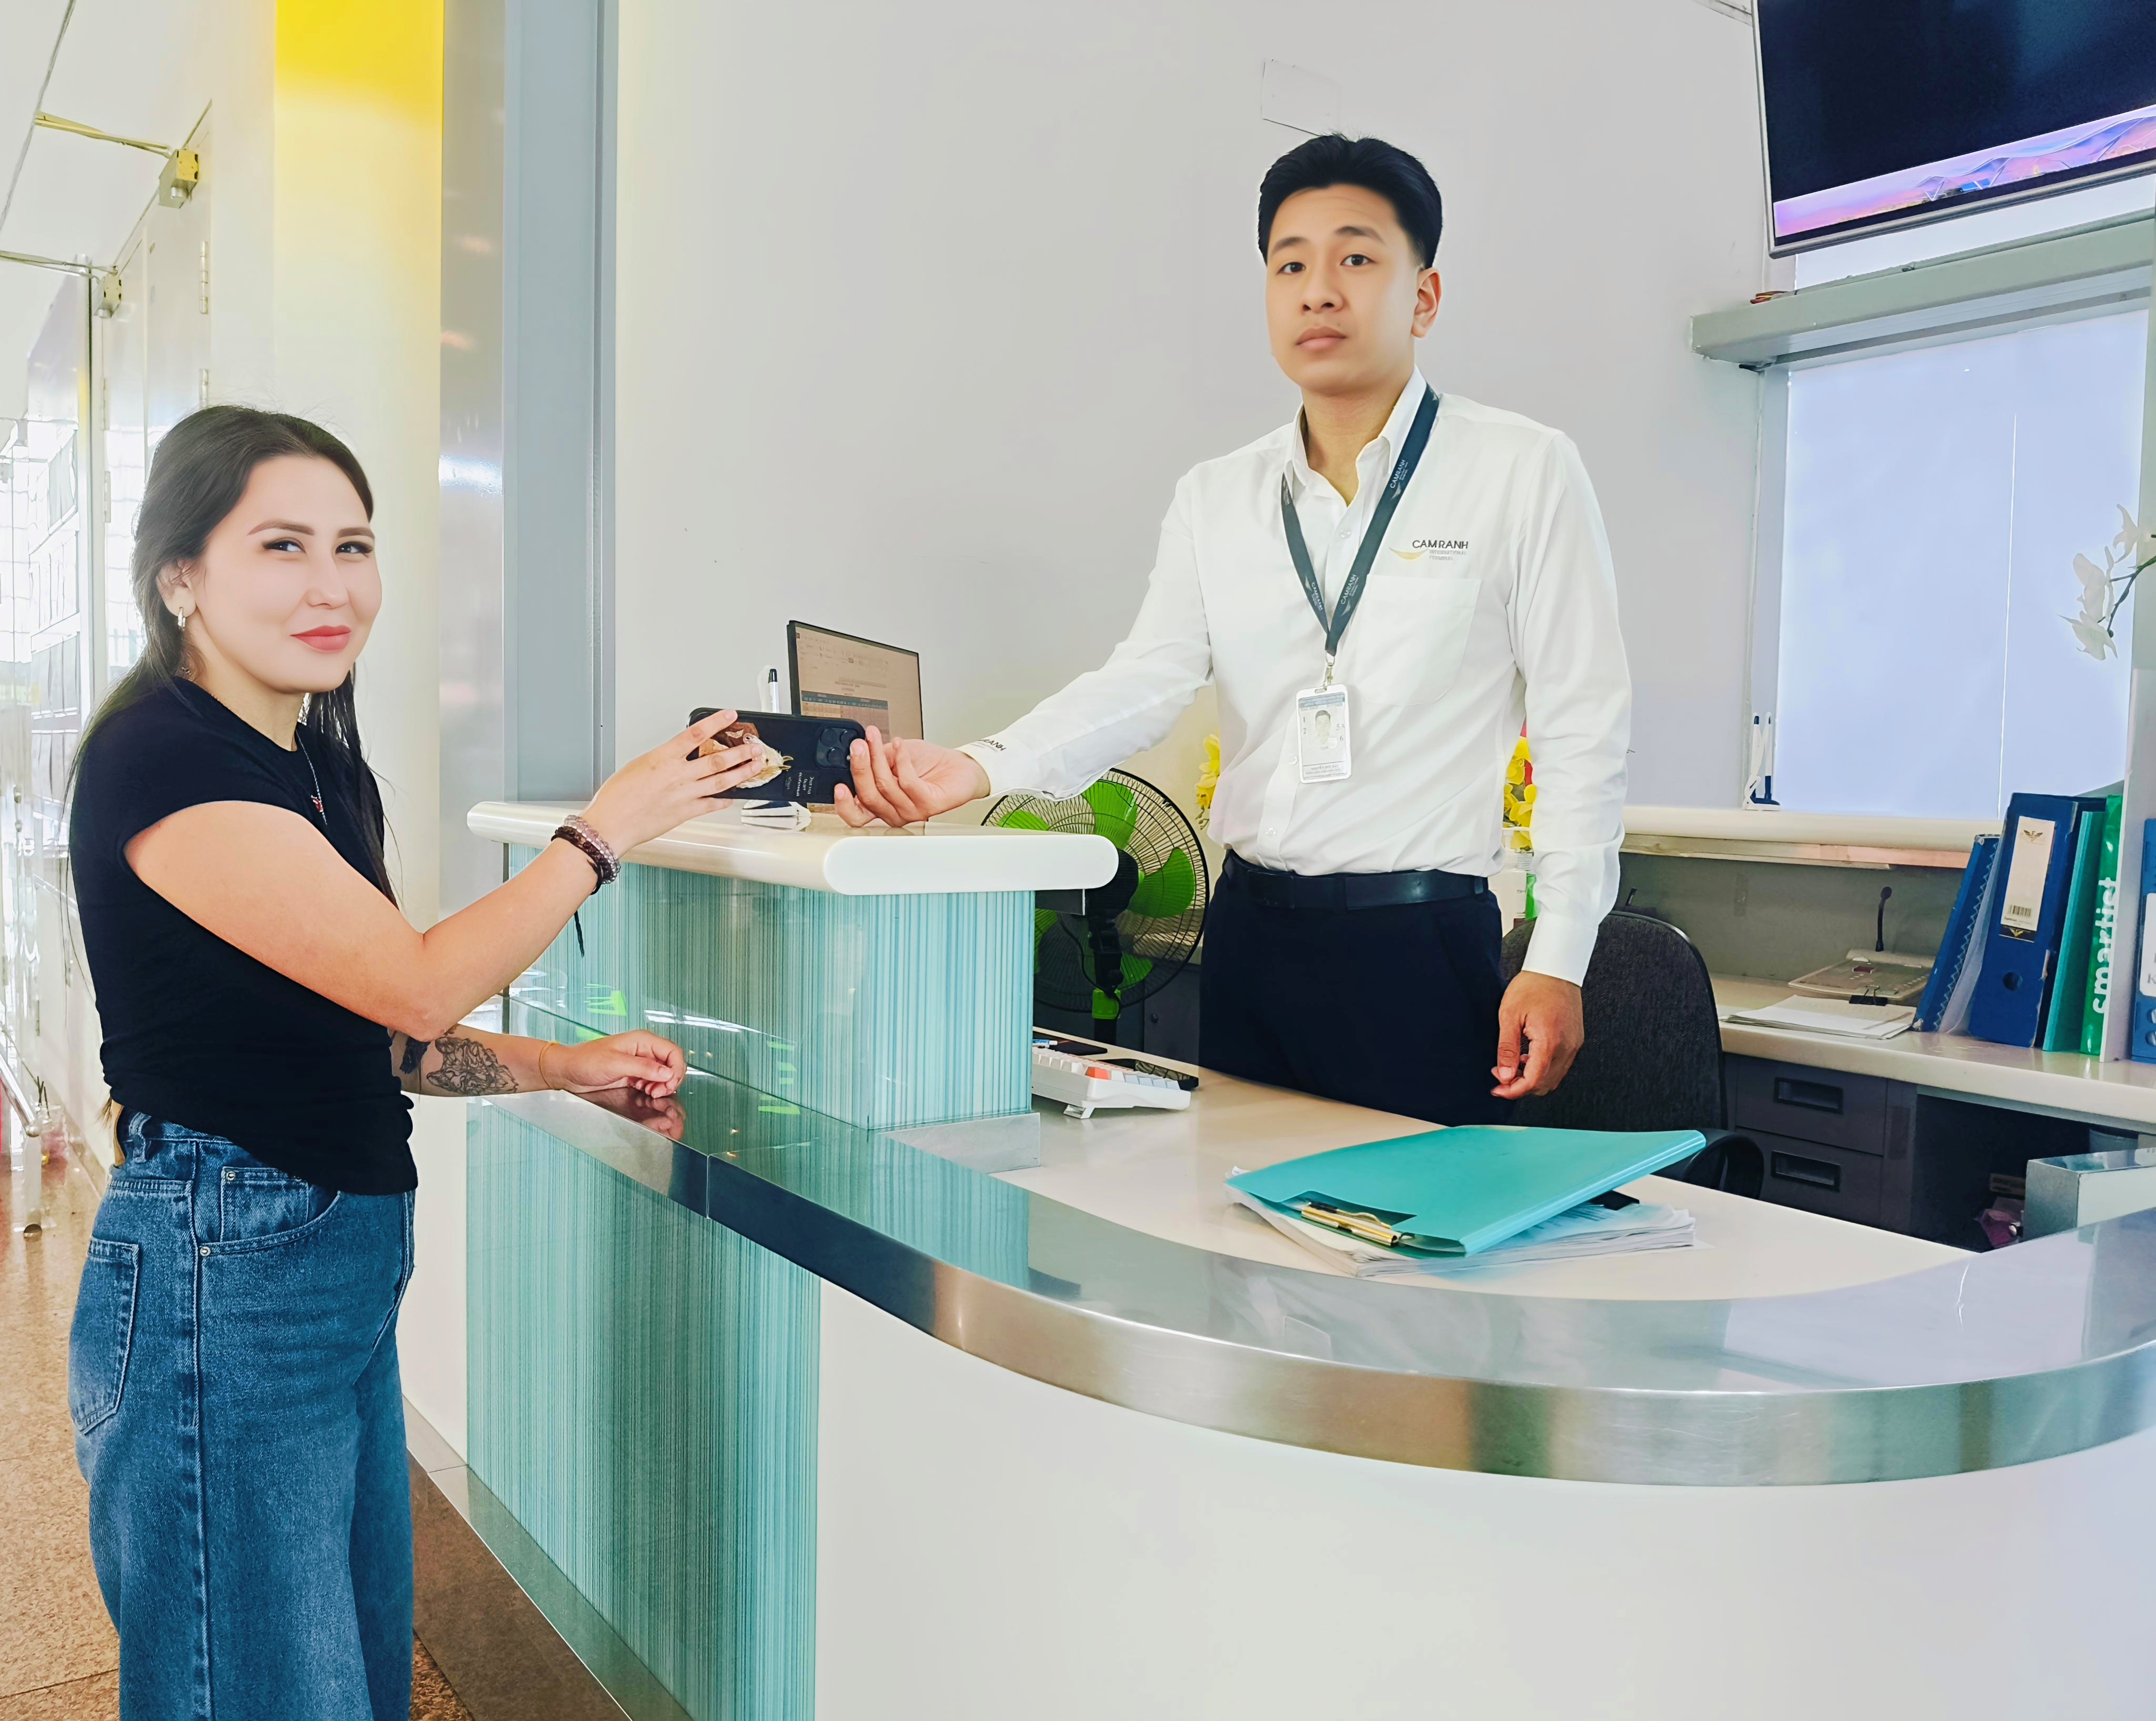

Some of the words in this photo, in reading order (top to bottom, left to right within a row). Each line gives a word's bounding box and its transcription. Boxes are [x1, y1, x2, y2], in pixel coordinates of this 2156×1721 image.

[1390, 459, 1406, 488] CAMRANH
[1412, 540, 1469, 549] CAMRANH
[1341, 574, 1357, 605] CAMRANH
